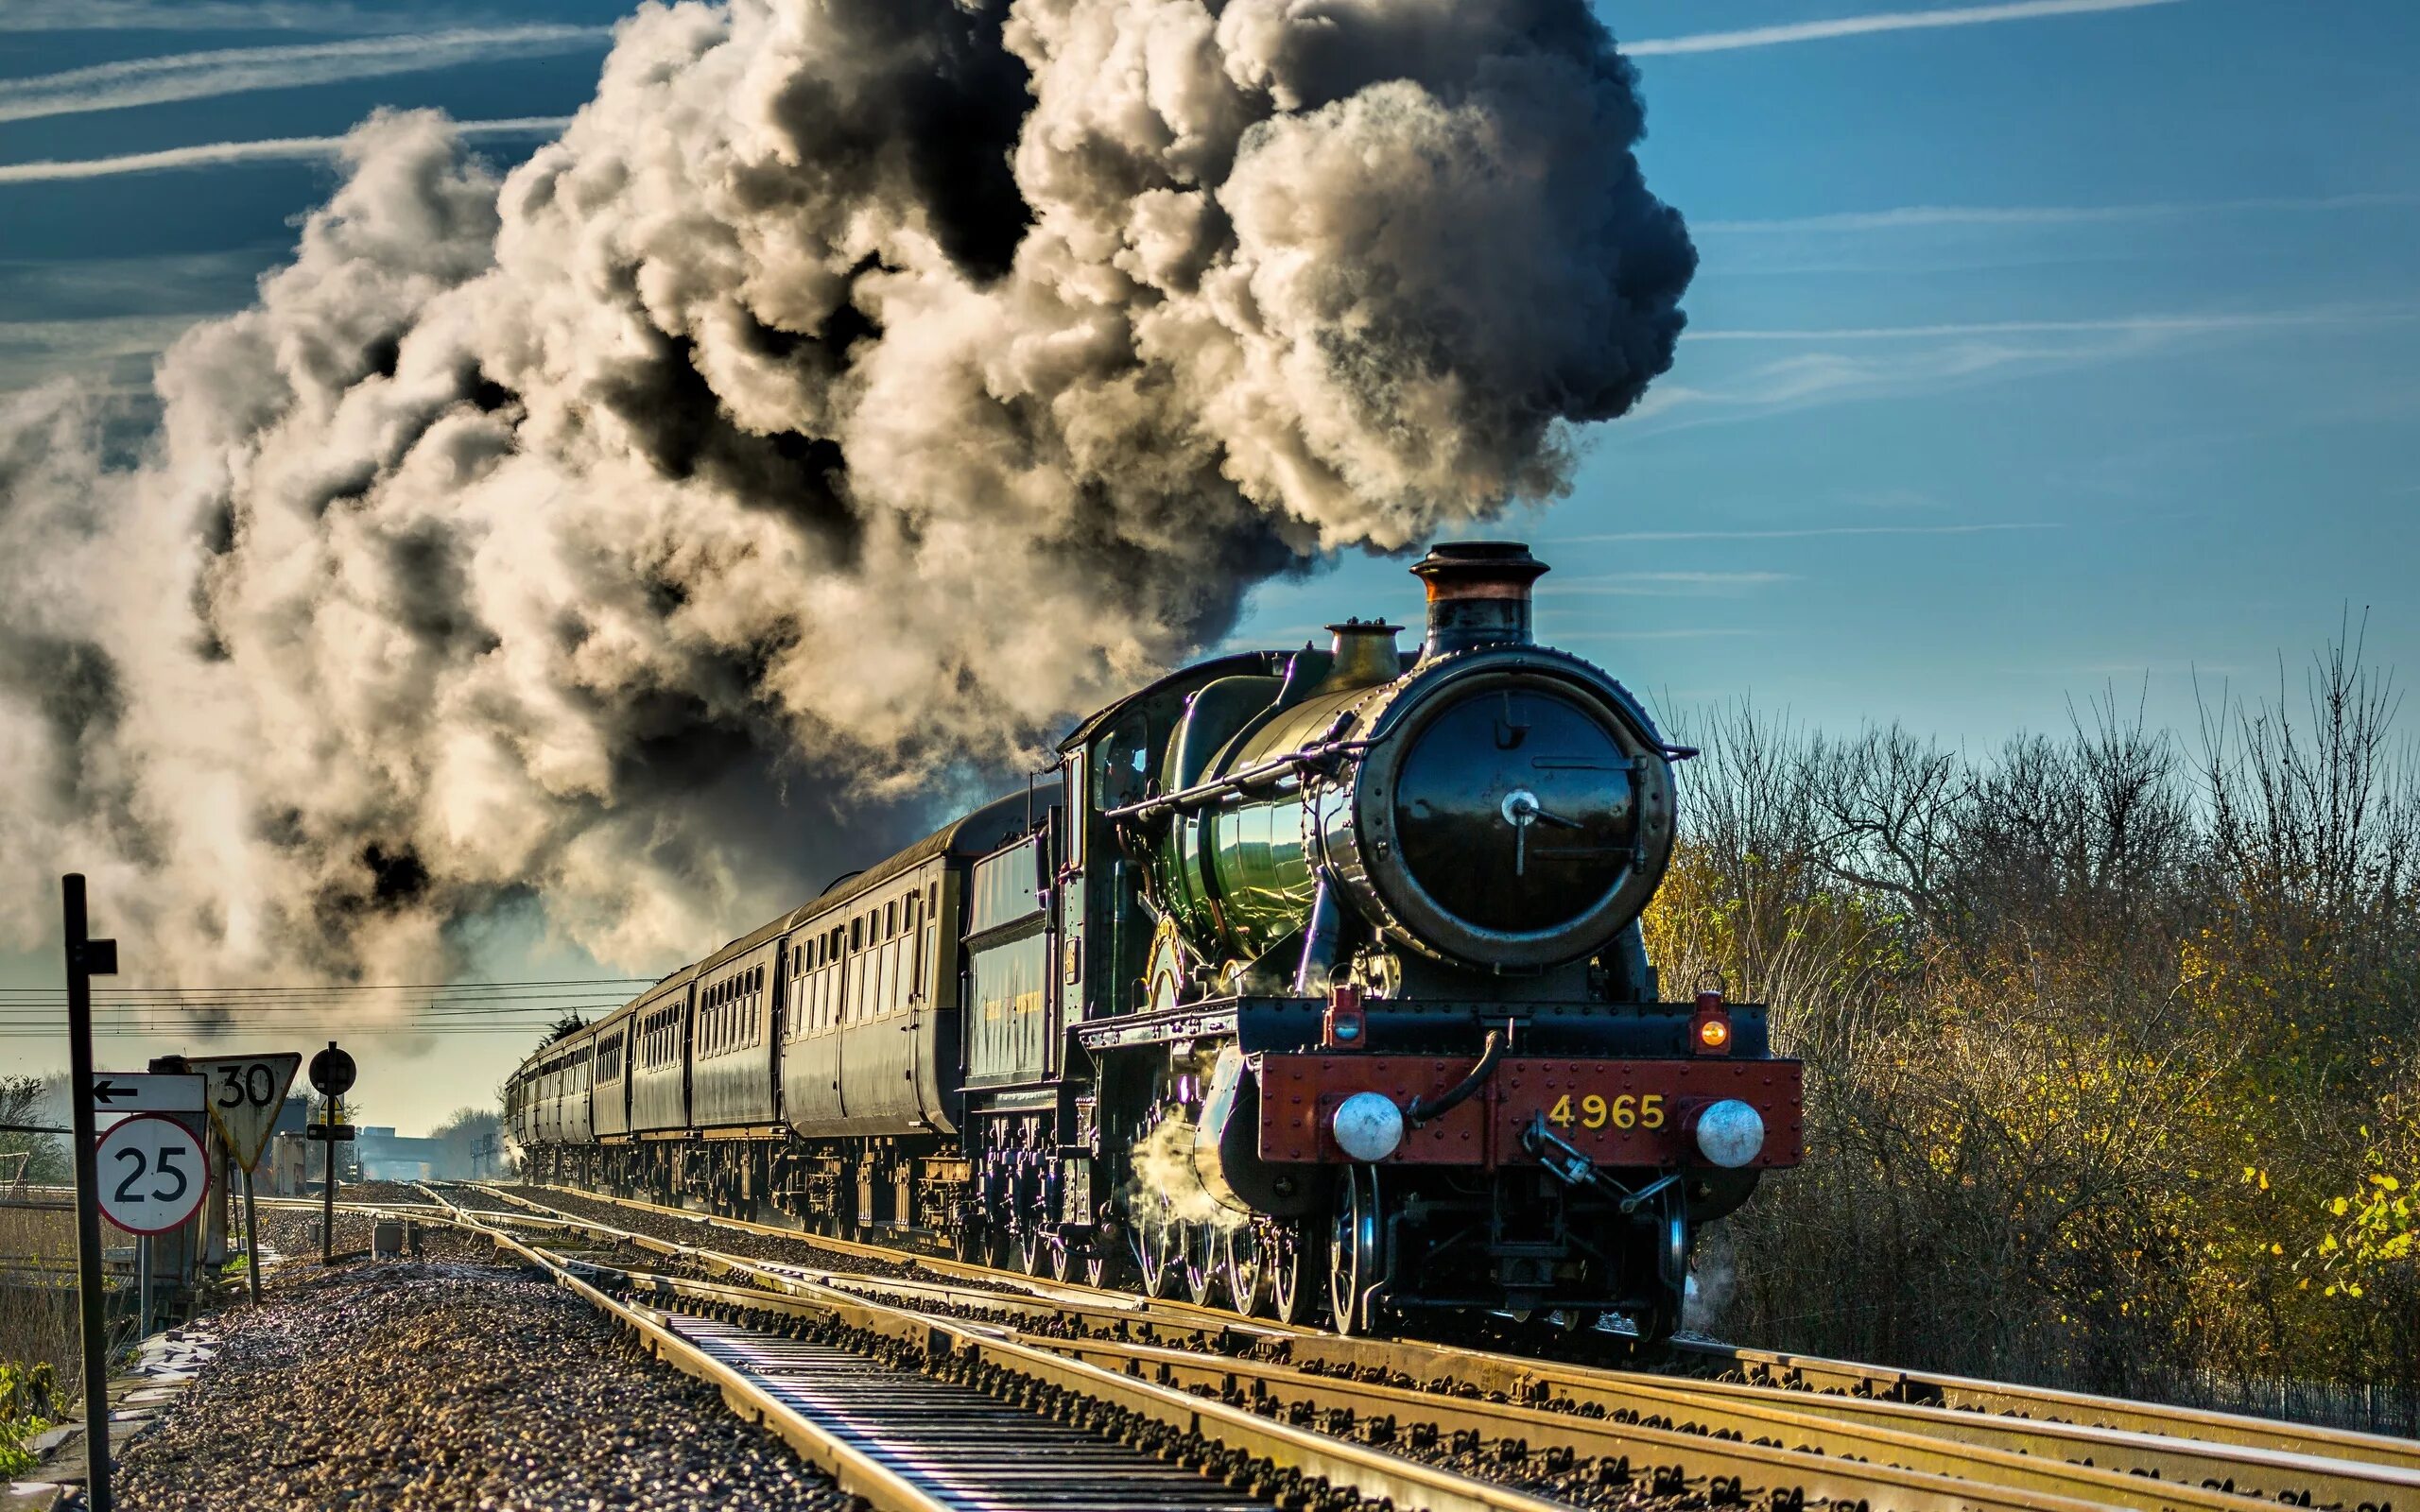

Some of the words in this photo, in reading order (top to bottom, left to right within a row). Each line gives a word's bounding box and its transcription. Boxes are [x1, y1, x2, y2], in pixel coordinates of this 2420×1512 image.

[217, 1063, 275, 1108] 30
[1549, 1094, 1665, 1128] 4965
[113, 1147, 188, 1202] 25
